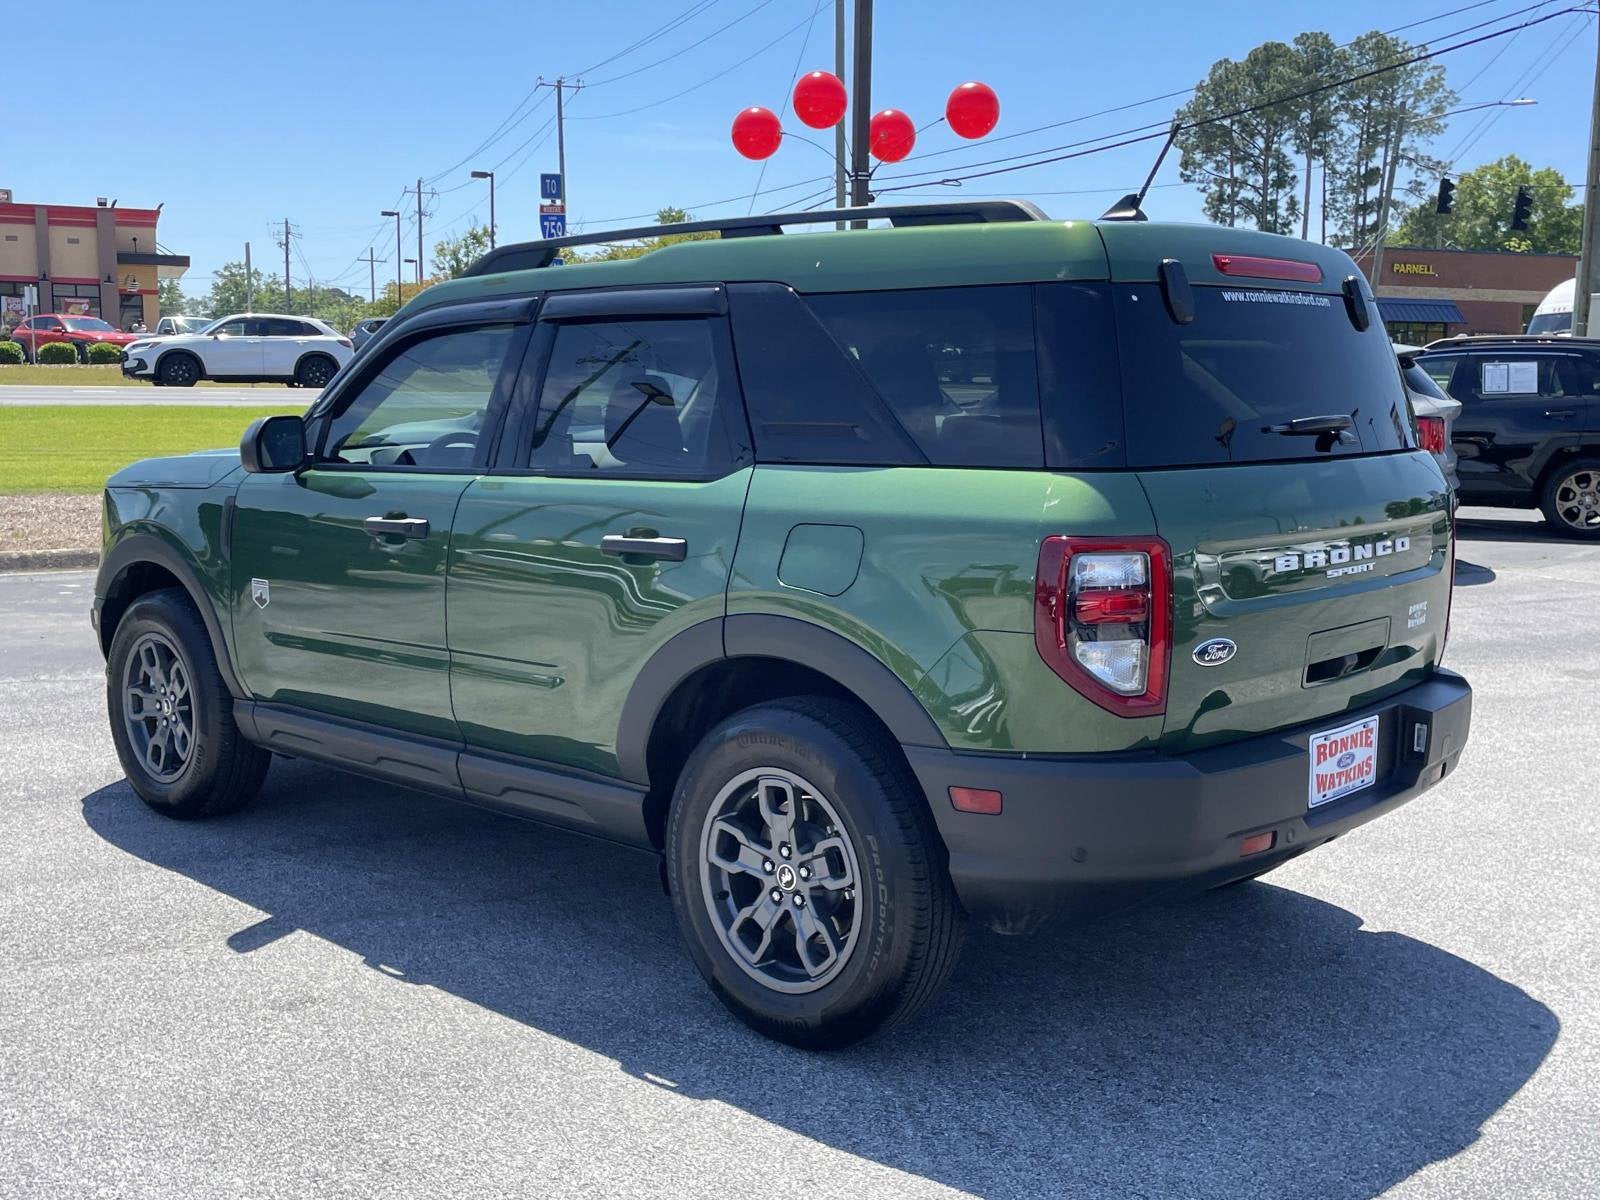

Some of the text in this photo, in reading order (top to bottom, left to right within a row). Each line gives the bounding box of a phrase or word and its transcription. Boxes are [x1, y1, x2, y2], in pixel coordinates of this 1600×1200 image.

[545, 179, 557, 194] TO
[543, 221, 563, 239] 759
[1393, 263, 1435, 275] PARNELL
[1221, 290, 1331, 307] www.ronniewatkinsford.com
[1274, 536, 1410, 573] BRONCO
[1326, 562, 1376, 579] SPORT
[1204, 643, 1230, 661] Ford
[1316, 727, 1374, 767] RONNIE
[1315, 755, 1373, 794] WATKINS
